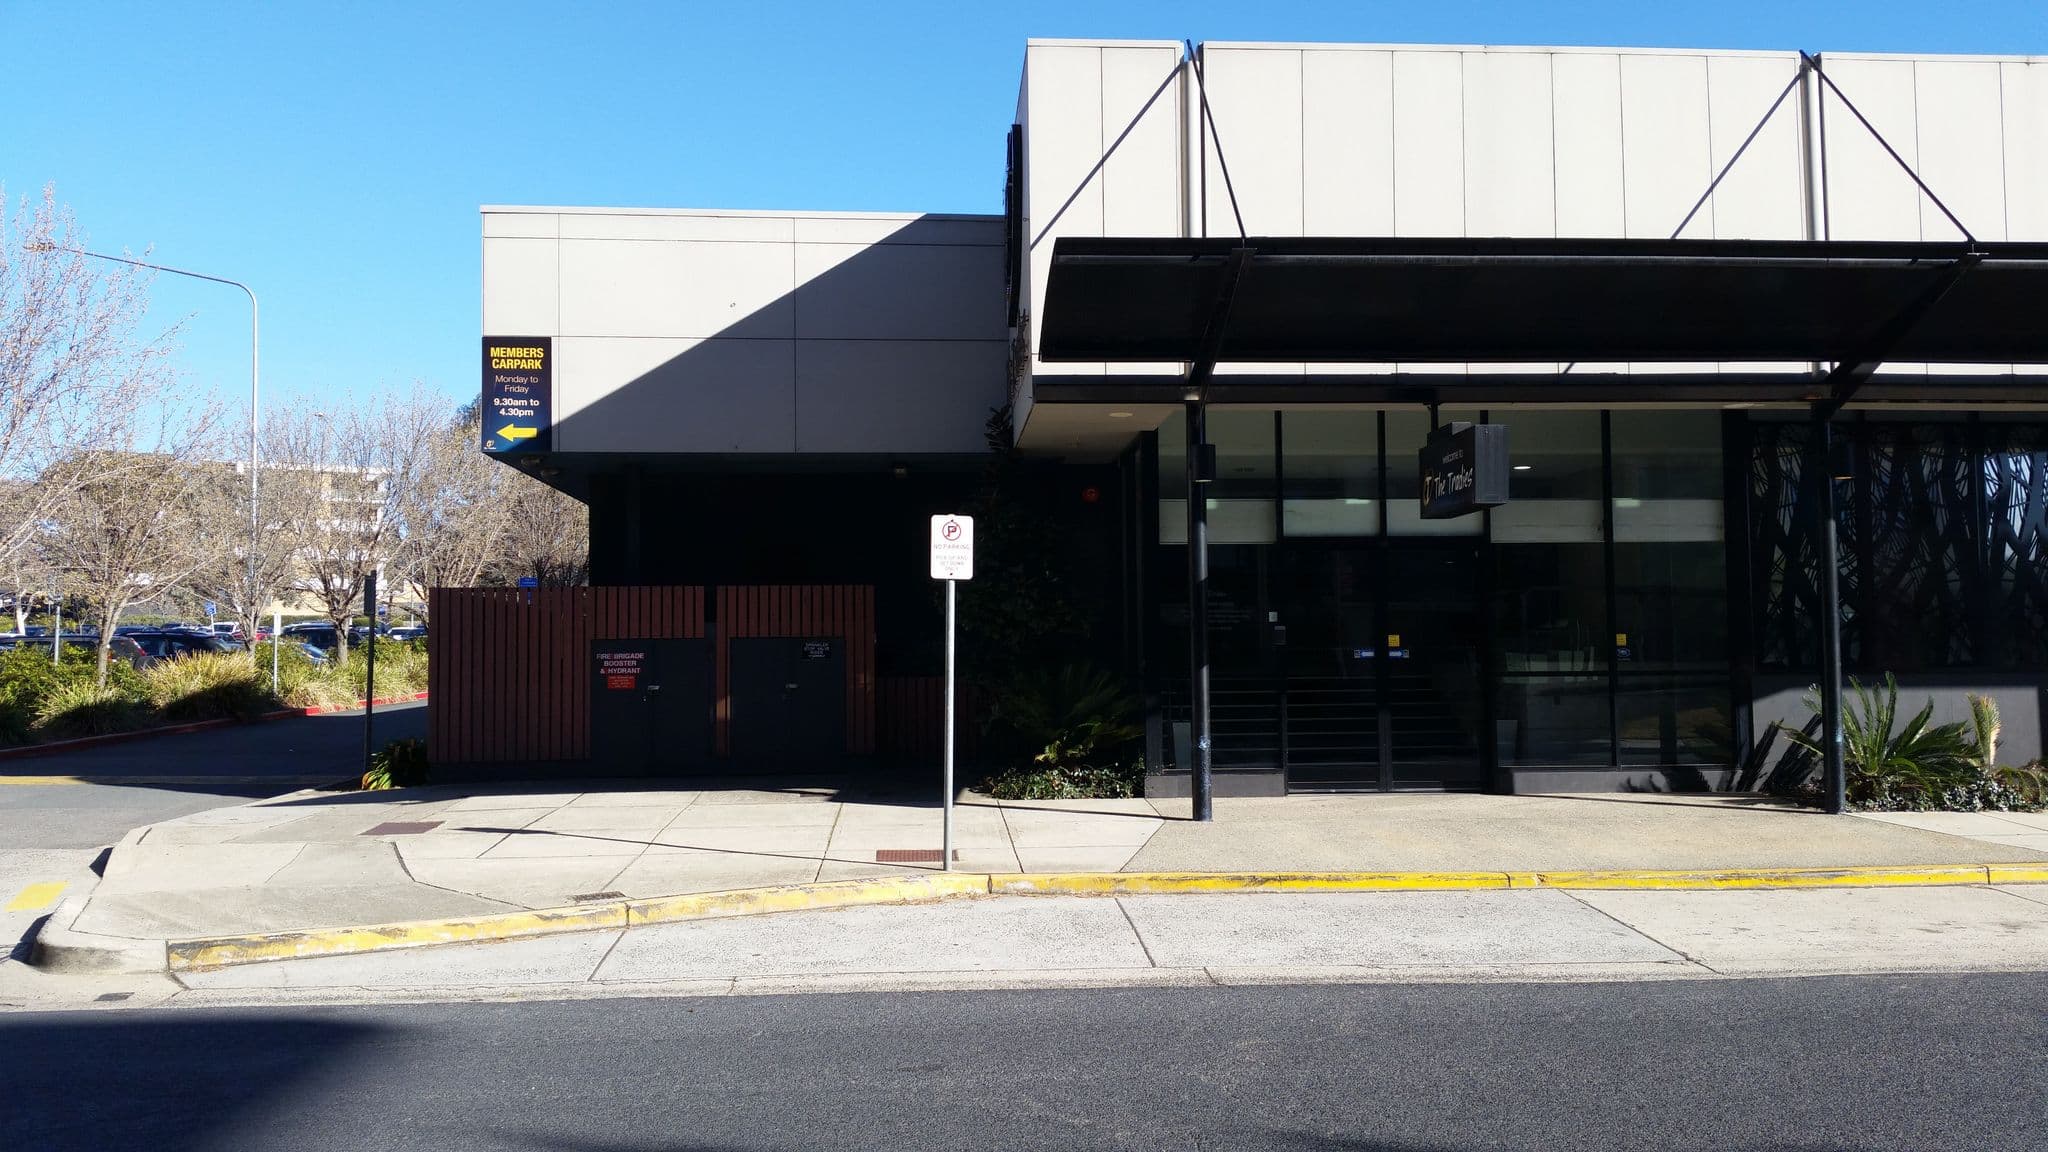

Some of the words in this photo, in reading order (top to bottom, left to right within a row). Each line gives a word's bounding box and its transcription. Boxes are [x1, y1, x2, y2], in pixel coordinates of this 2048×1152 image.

[490, 347, 544, 358] MEMBERS
[492, 359, 542, 369] CARPARK
[495, 375, 528, 384] Monday
[530, 375, 538, 383] to
[504, 385, 529, 394] Friday
[493, 398, 527, 406] 9.30am
[530, 398, 539, 406] to
[499, 408, 533, 417] 4.30pm
[1434, 471, 1446, 499] The
[1447, 464, 1473, 495] Tradies
